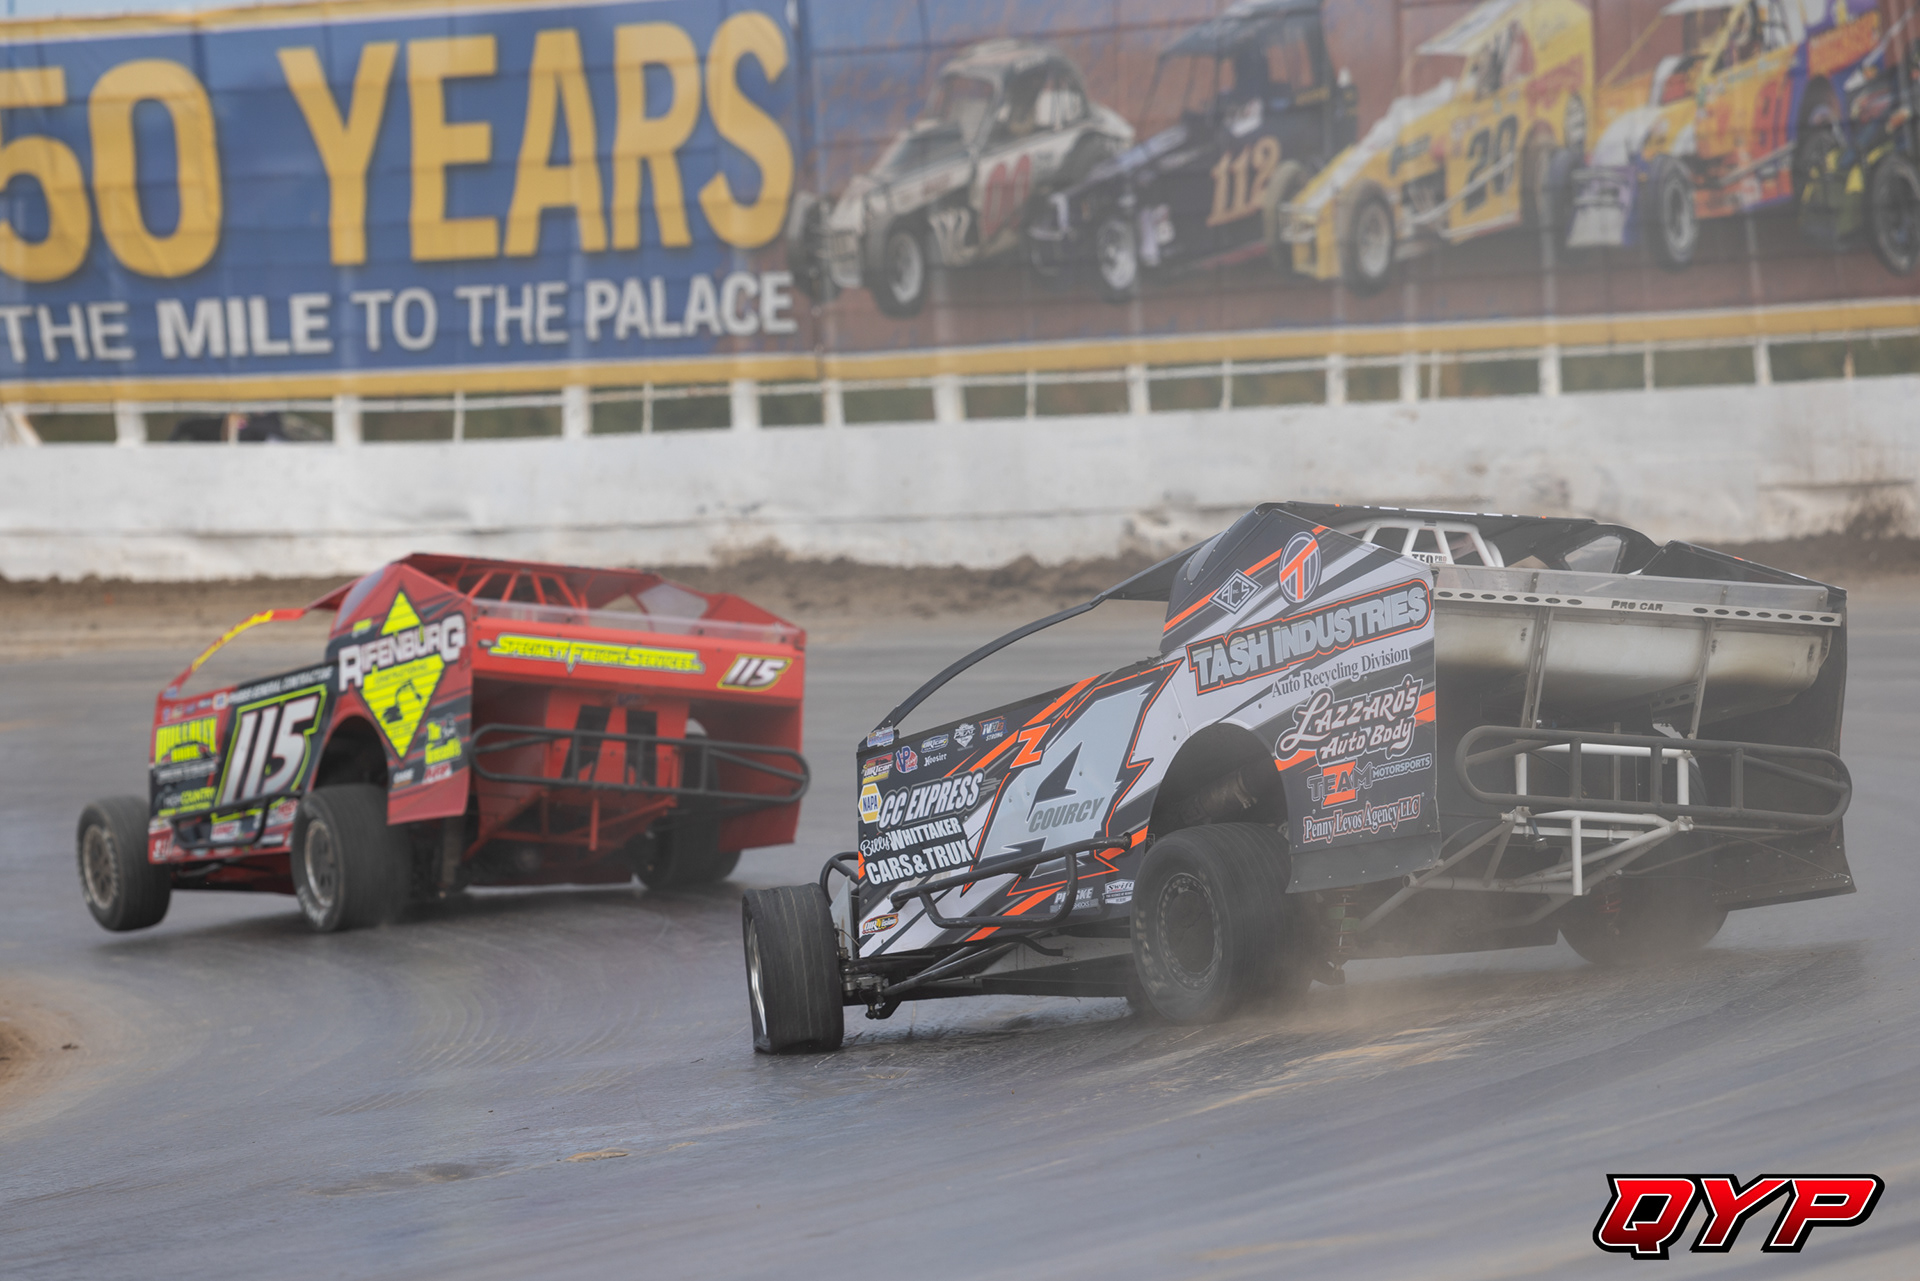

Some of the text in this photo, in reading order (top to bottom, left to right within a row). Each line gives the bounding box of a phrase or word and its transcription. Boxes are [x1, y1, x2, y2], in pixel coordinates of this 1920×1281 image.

[0, 11, 794, 282] 50 YEARS
[1207, 138, 1280, 226] 112
[0, 272, 797, 361] THE MILE TO THE PALACE
[1611, 600, 1663, 611] PRO CAR
[339, 614, 465, 691] RIFENBURG
[490, 635, 698, 669] SPECIALTY FREIGHT SERVICES
[1193, 586, 1428, 687] TASH INDUSTRIES
[723, 659, 786, 687] 115
[1272, 648, 1409, 697] Auto Recycling Division
[1280, 681, 1418, 751] LAZZARO'S
[222, 696, 319, 806] 115
[896, 746, 911, 772] VP
[923, 753, 947, 767] Hoosier
[1320, 719, 1412, 759] Auto Body
[979, 684, 1153, 859] 4
[1308, 757, 1430, 801] TEAM MOTORSPORTS
[862, 795, 879, 812] NAPA
[879, 773, 984, 829] CC EXPRESS
[1028, 798, 1104, 833] COURCY
[1305, 799, 1419, 840] Penny Levos Agency LLC
[860, 817, 962, 857] Billy WHITTAKER
[1107, 881, 1132, 891] Swift
